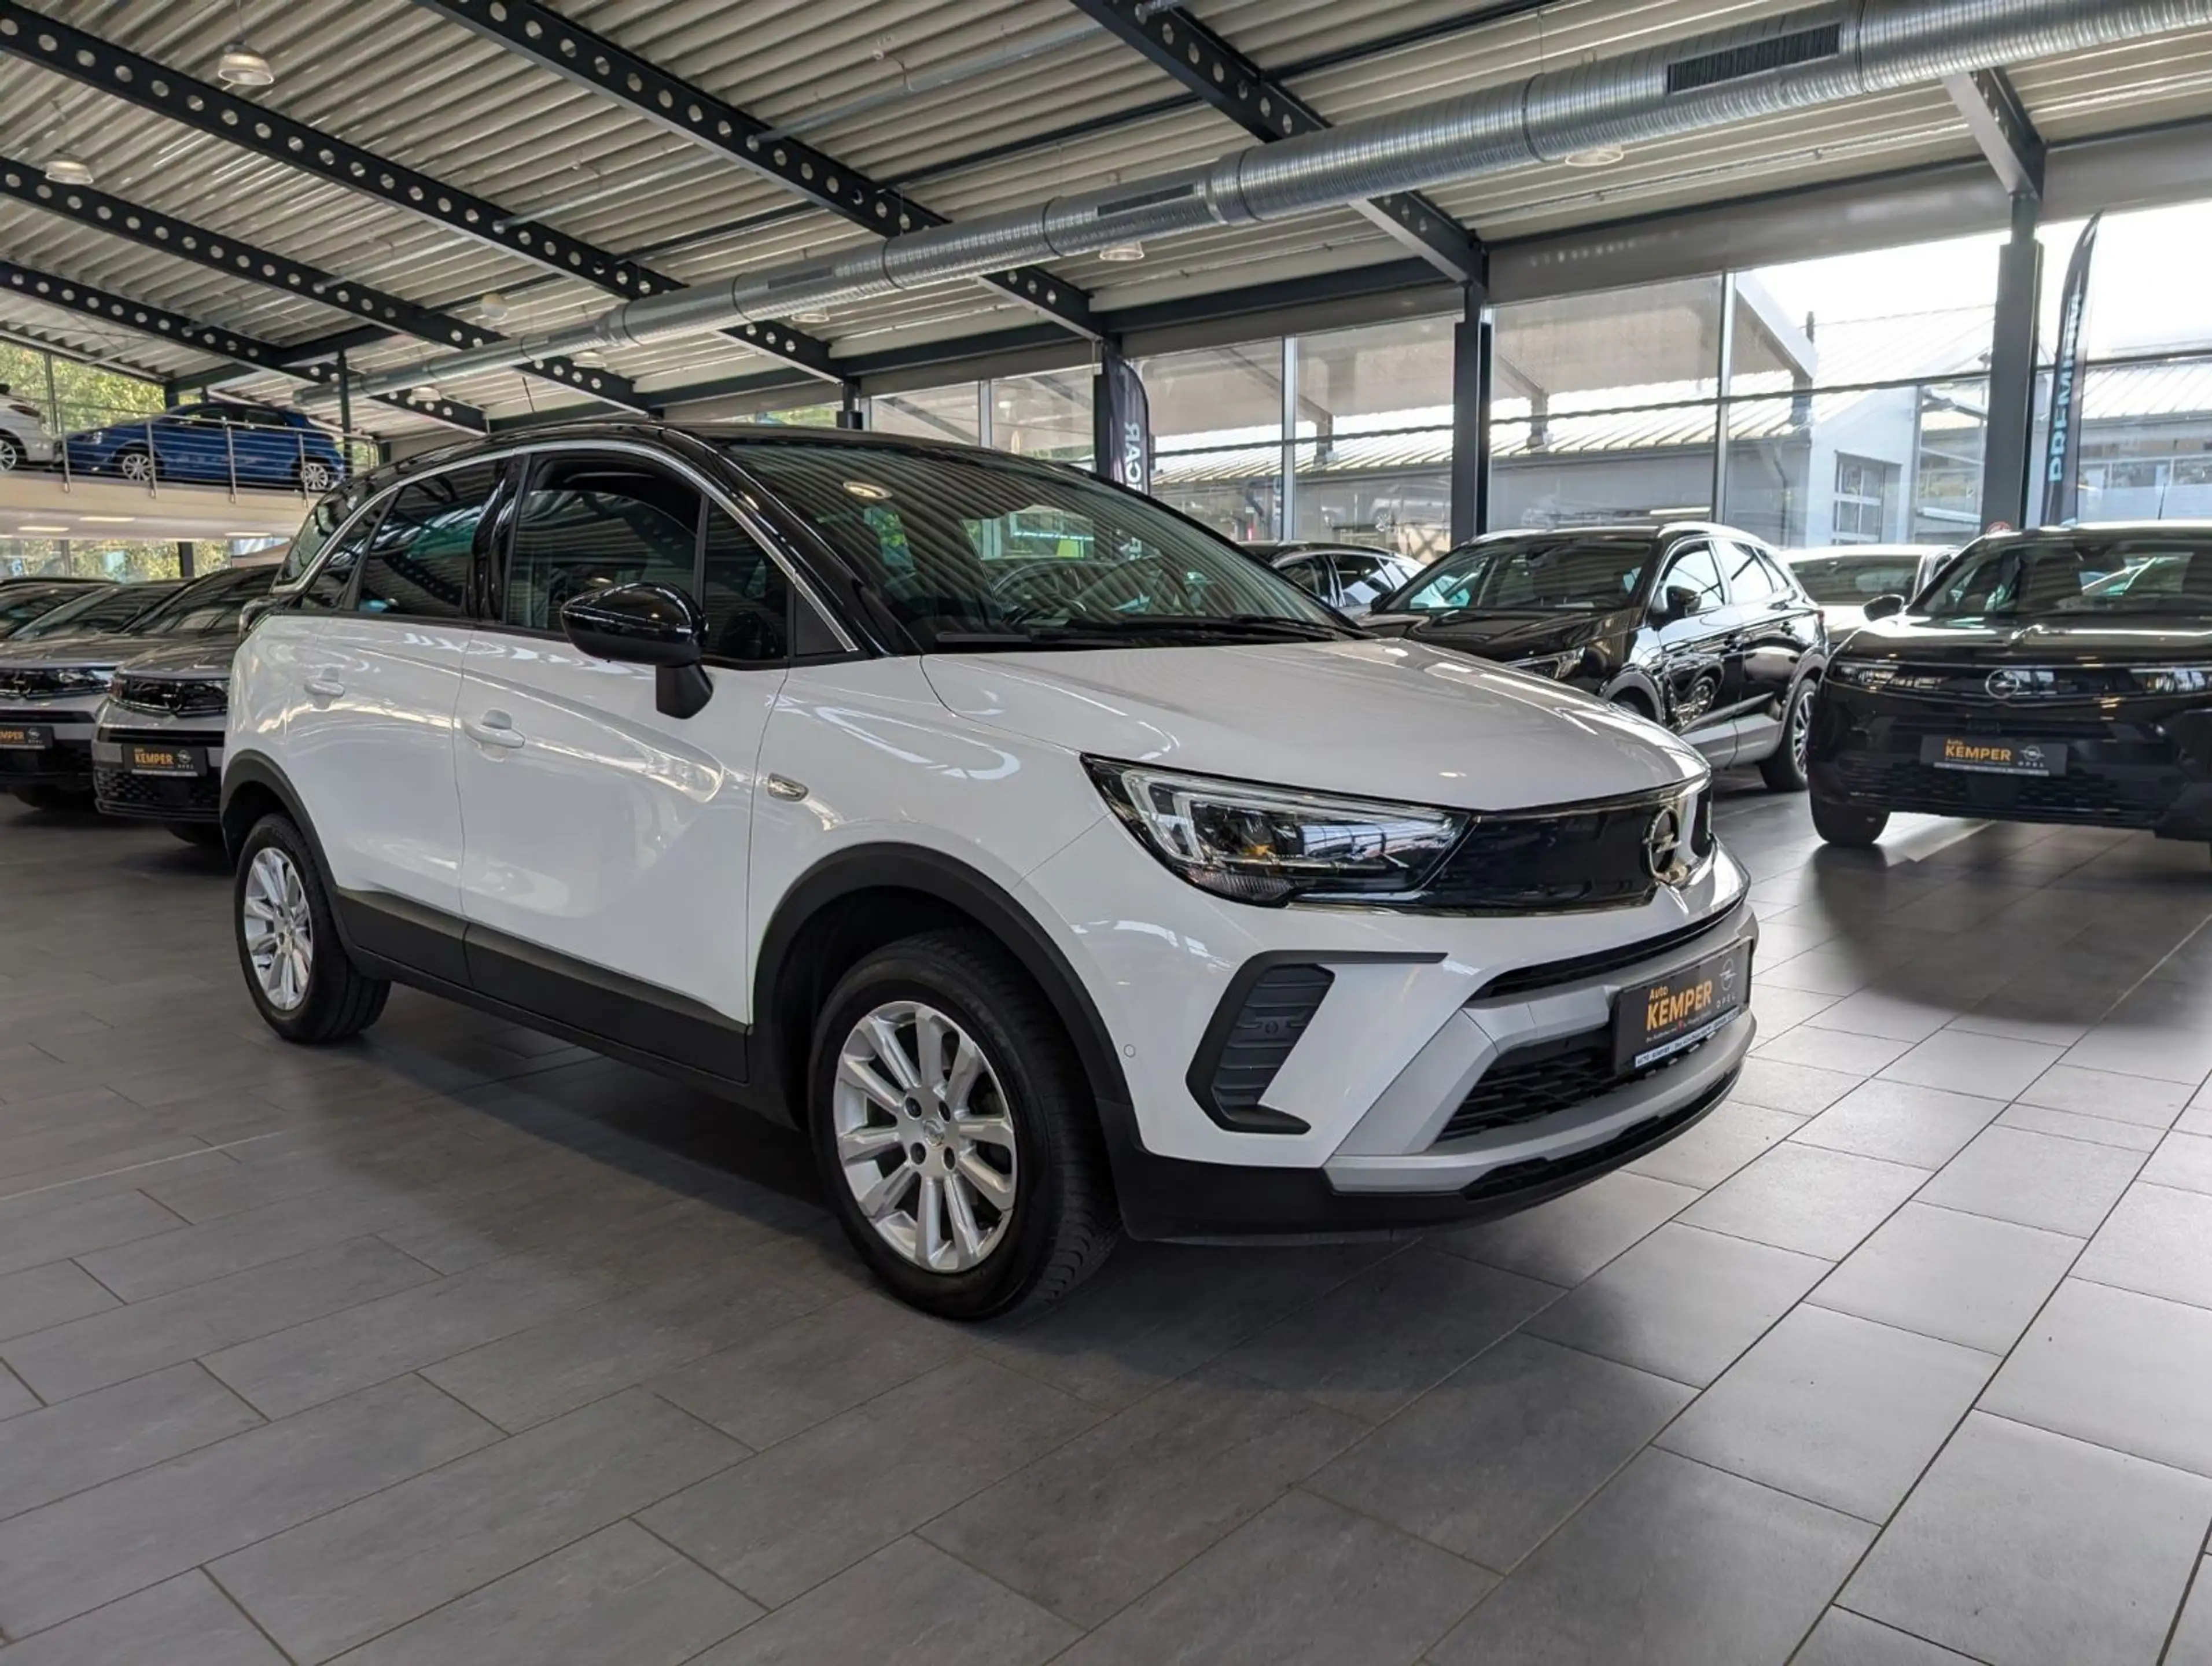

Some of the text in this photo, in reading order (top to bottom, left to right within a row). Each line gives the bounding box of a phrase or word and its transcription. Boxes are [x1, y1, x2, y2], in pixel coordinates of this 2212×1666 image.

[134, 753, 174, 764] KEMPER
[1945, 745, 2011, 761] KEMPER
[1649, 985, 1669, 1001] Auto
[1646, 979, 1713, 1031] KEMPER
